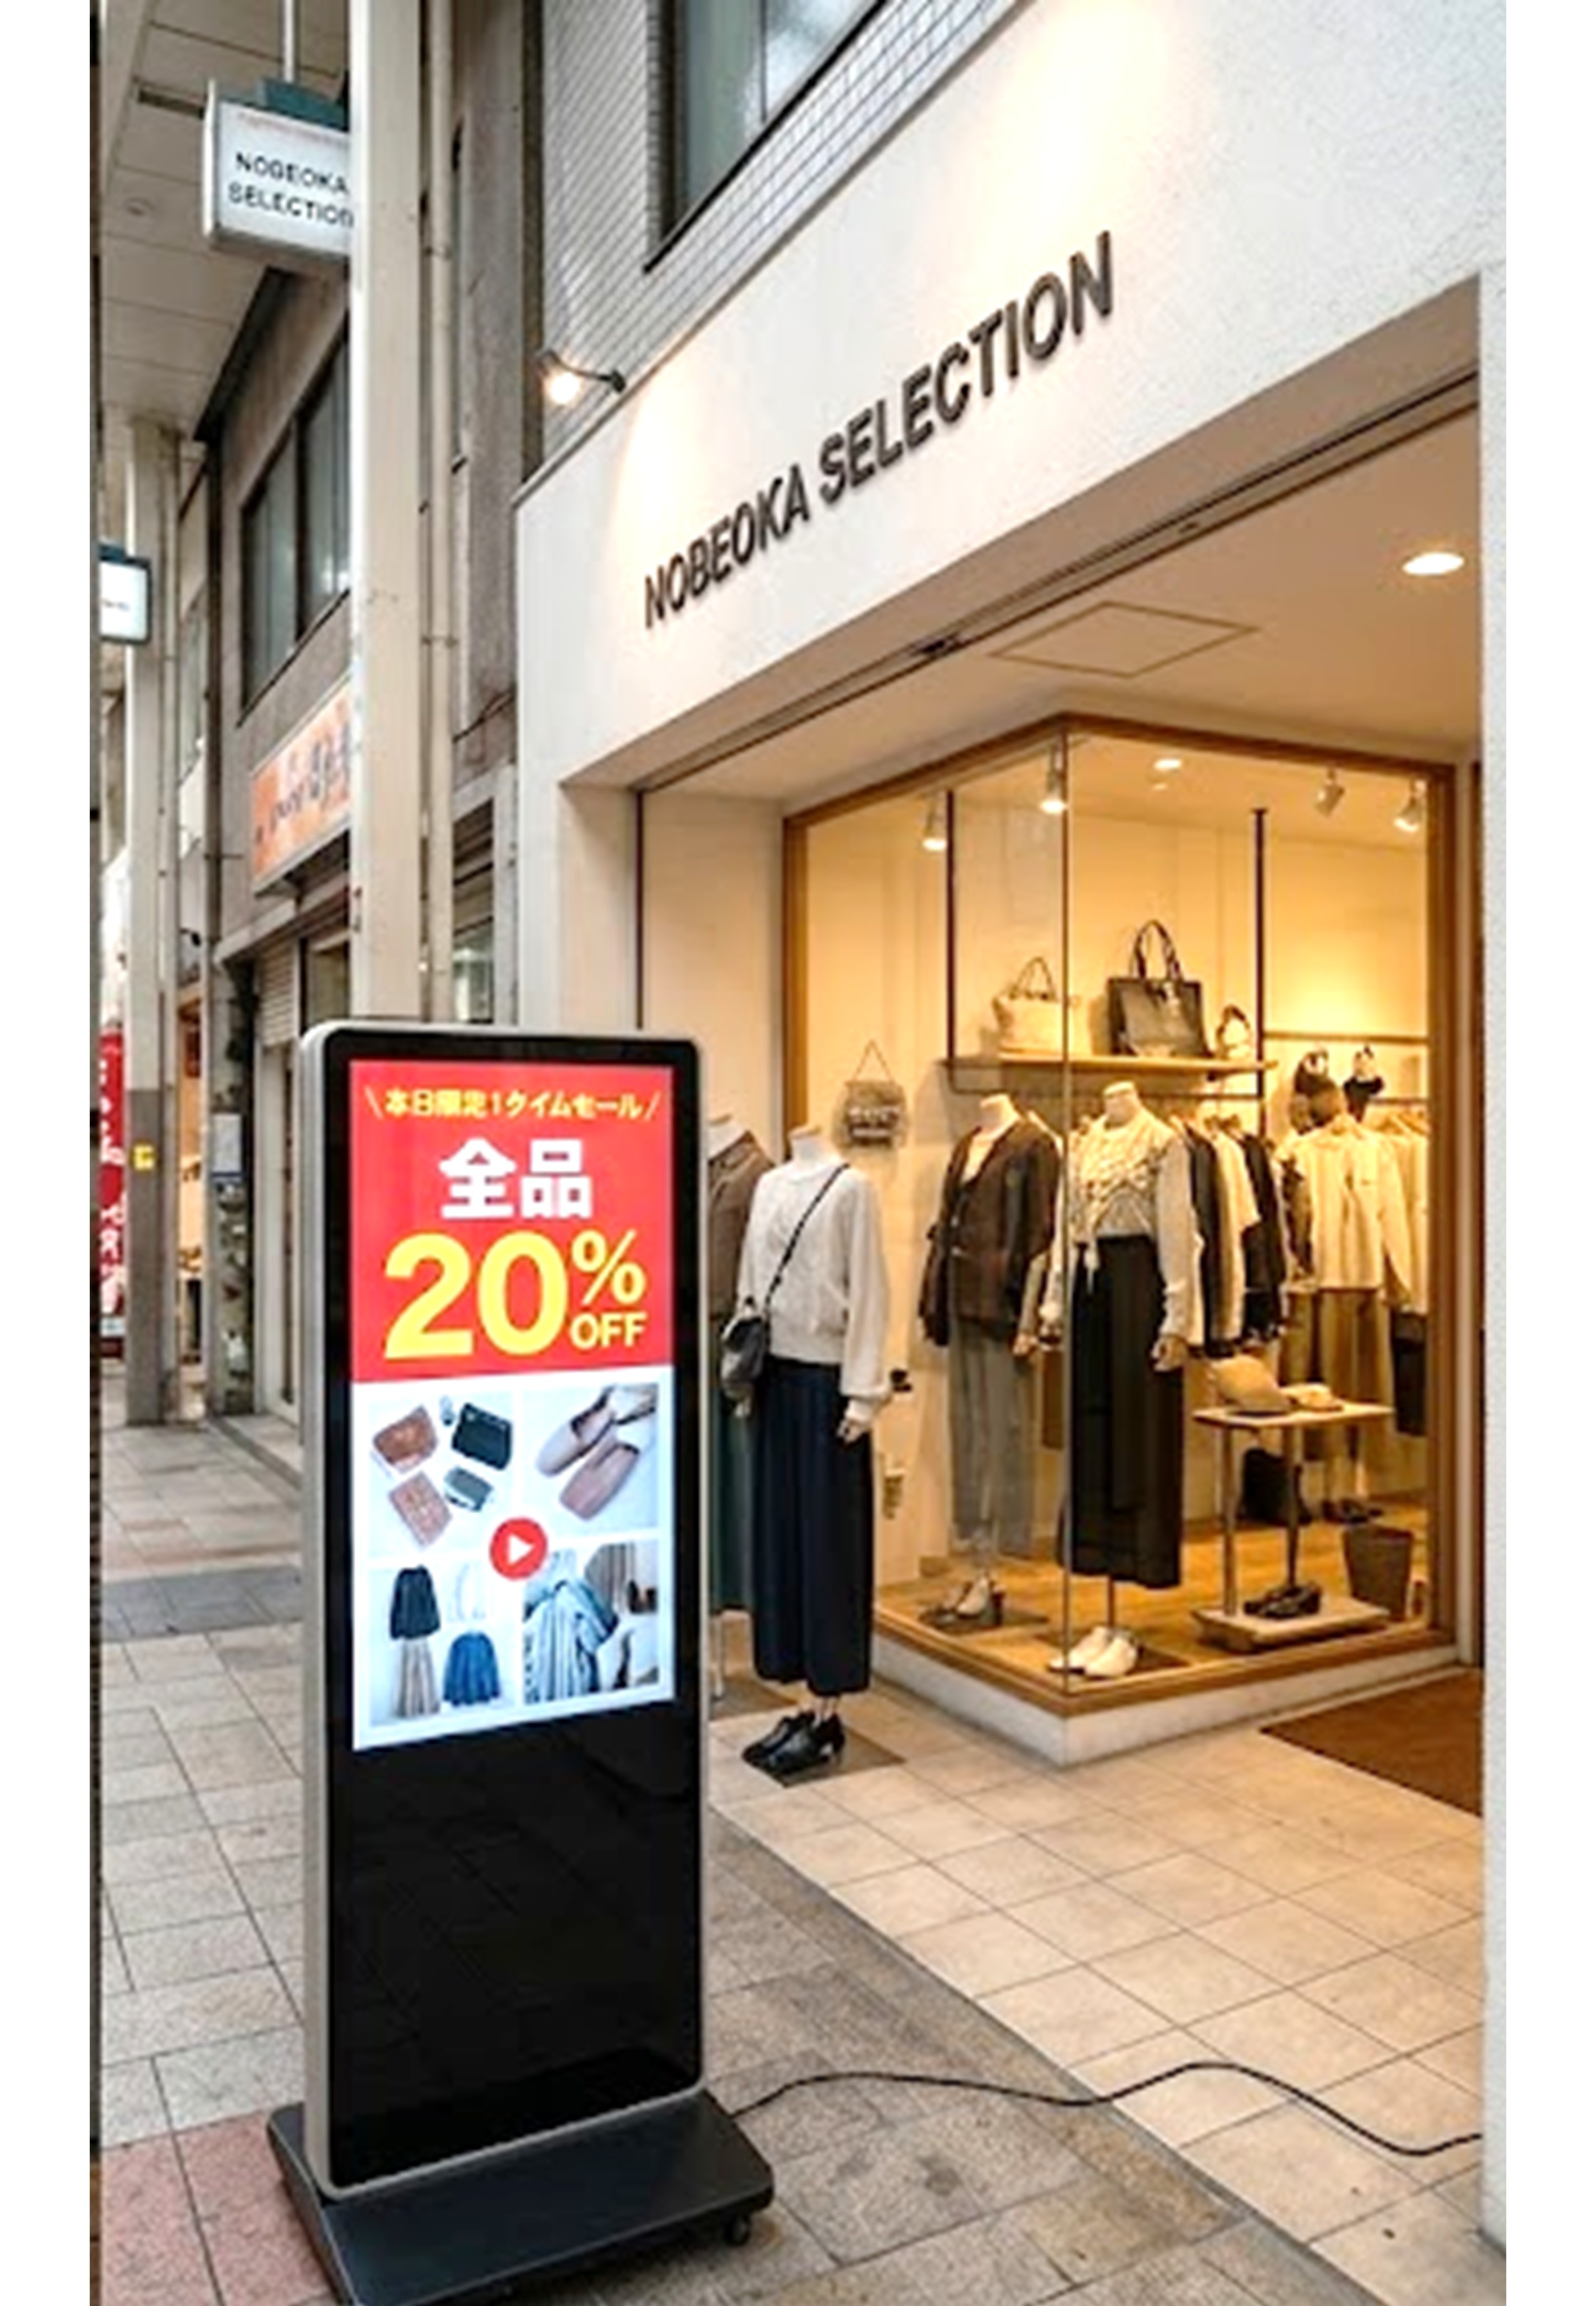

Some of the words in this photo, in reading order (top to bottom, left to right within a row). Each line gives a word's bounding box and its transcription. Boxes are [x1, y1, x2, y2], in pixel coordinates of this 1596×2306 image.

[236, 152, 348, 193] NOBEOKA
[645, 464, 810, 628] NOBEOKA
[820, 230, 1113, 507] SELECTION
[438, 1137, 592, 1220] 全品
[569, 1311, 647, 1349] OFF
